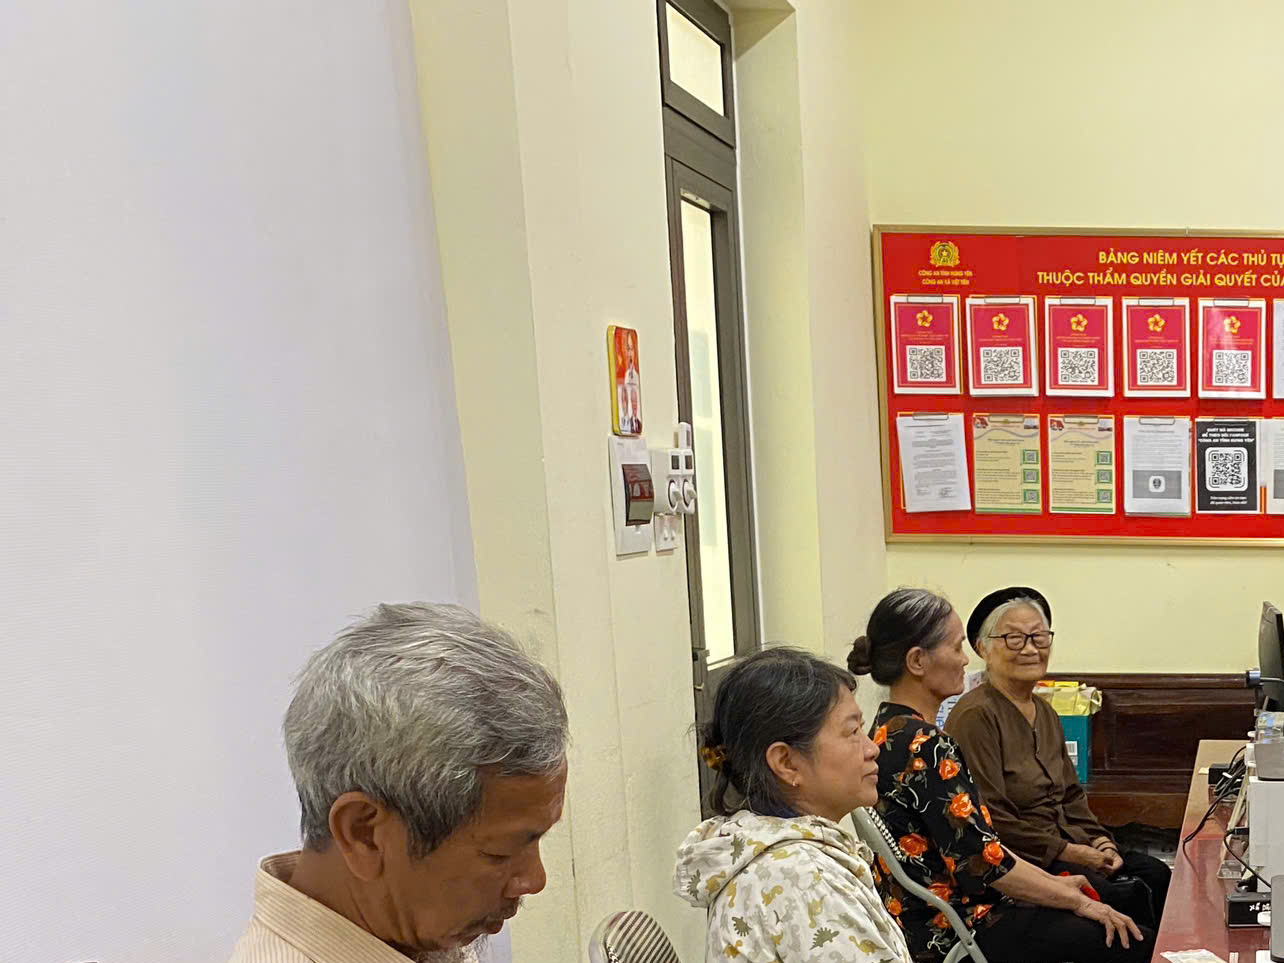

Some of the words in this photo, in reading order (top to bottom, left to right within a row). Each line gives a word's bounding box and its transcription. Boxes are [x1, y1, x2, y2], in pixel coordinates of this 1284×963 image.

[1098, 247, 1139, 264] BẢNG
[1143, 249, 1177, 264] NIÊM
[1181, 248, 1203, 265] YẾT
[1206, 249, 1239, 265] CÁC
[1242, 249, 1267, 265] THỦ
[1037, 269, 1085, 287] THUỘC
[1087, 267, 1127, 285] THẨM
[1130, 268, 1177, 286] QUYỀN
[1181, 270, 1211, 286] GIẢI
[1214, 270, 1257, 287] QUYẾT
